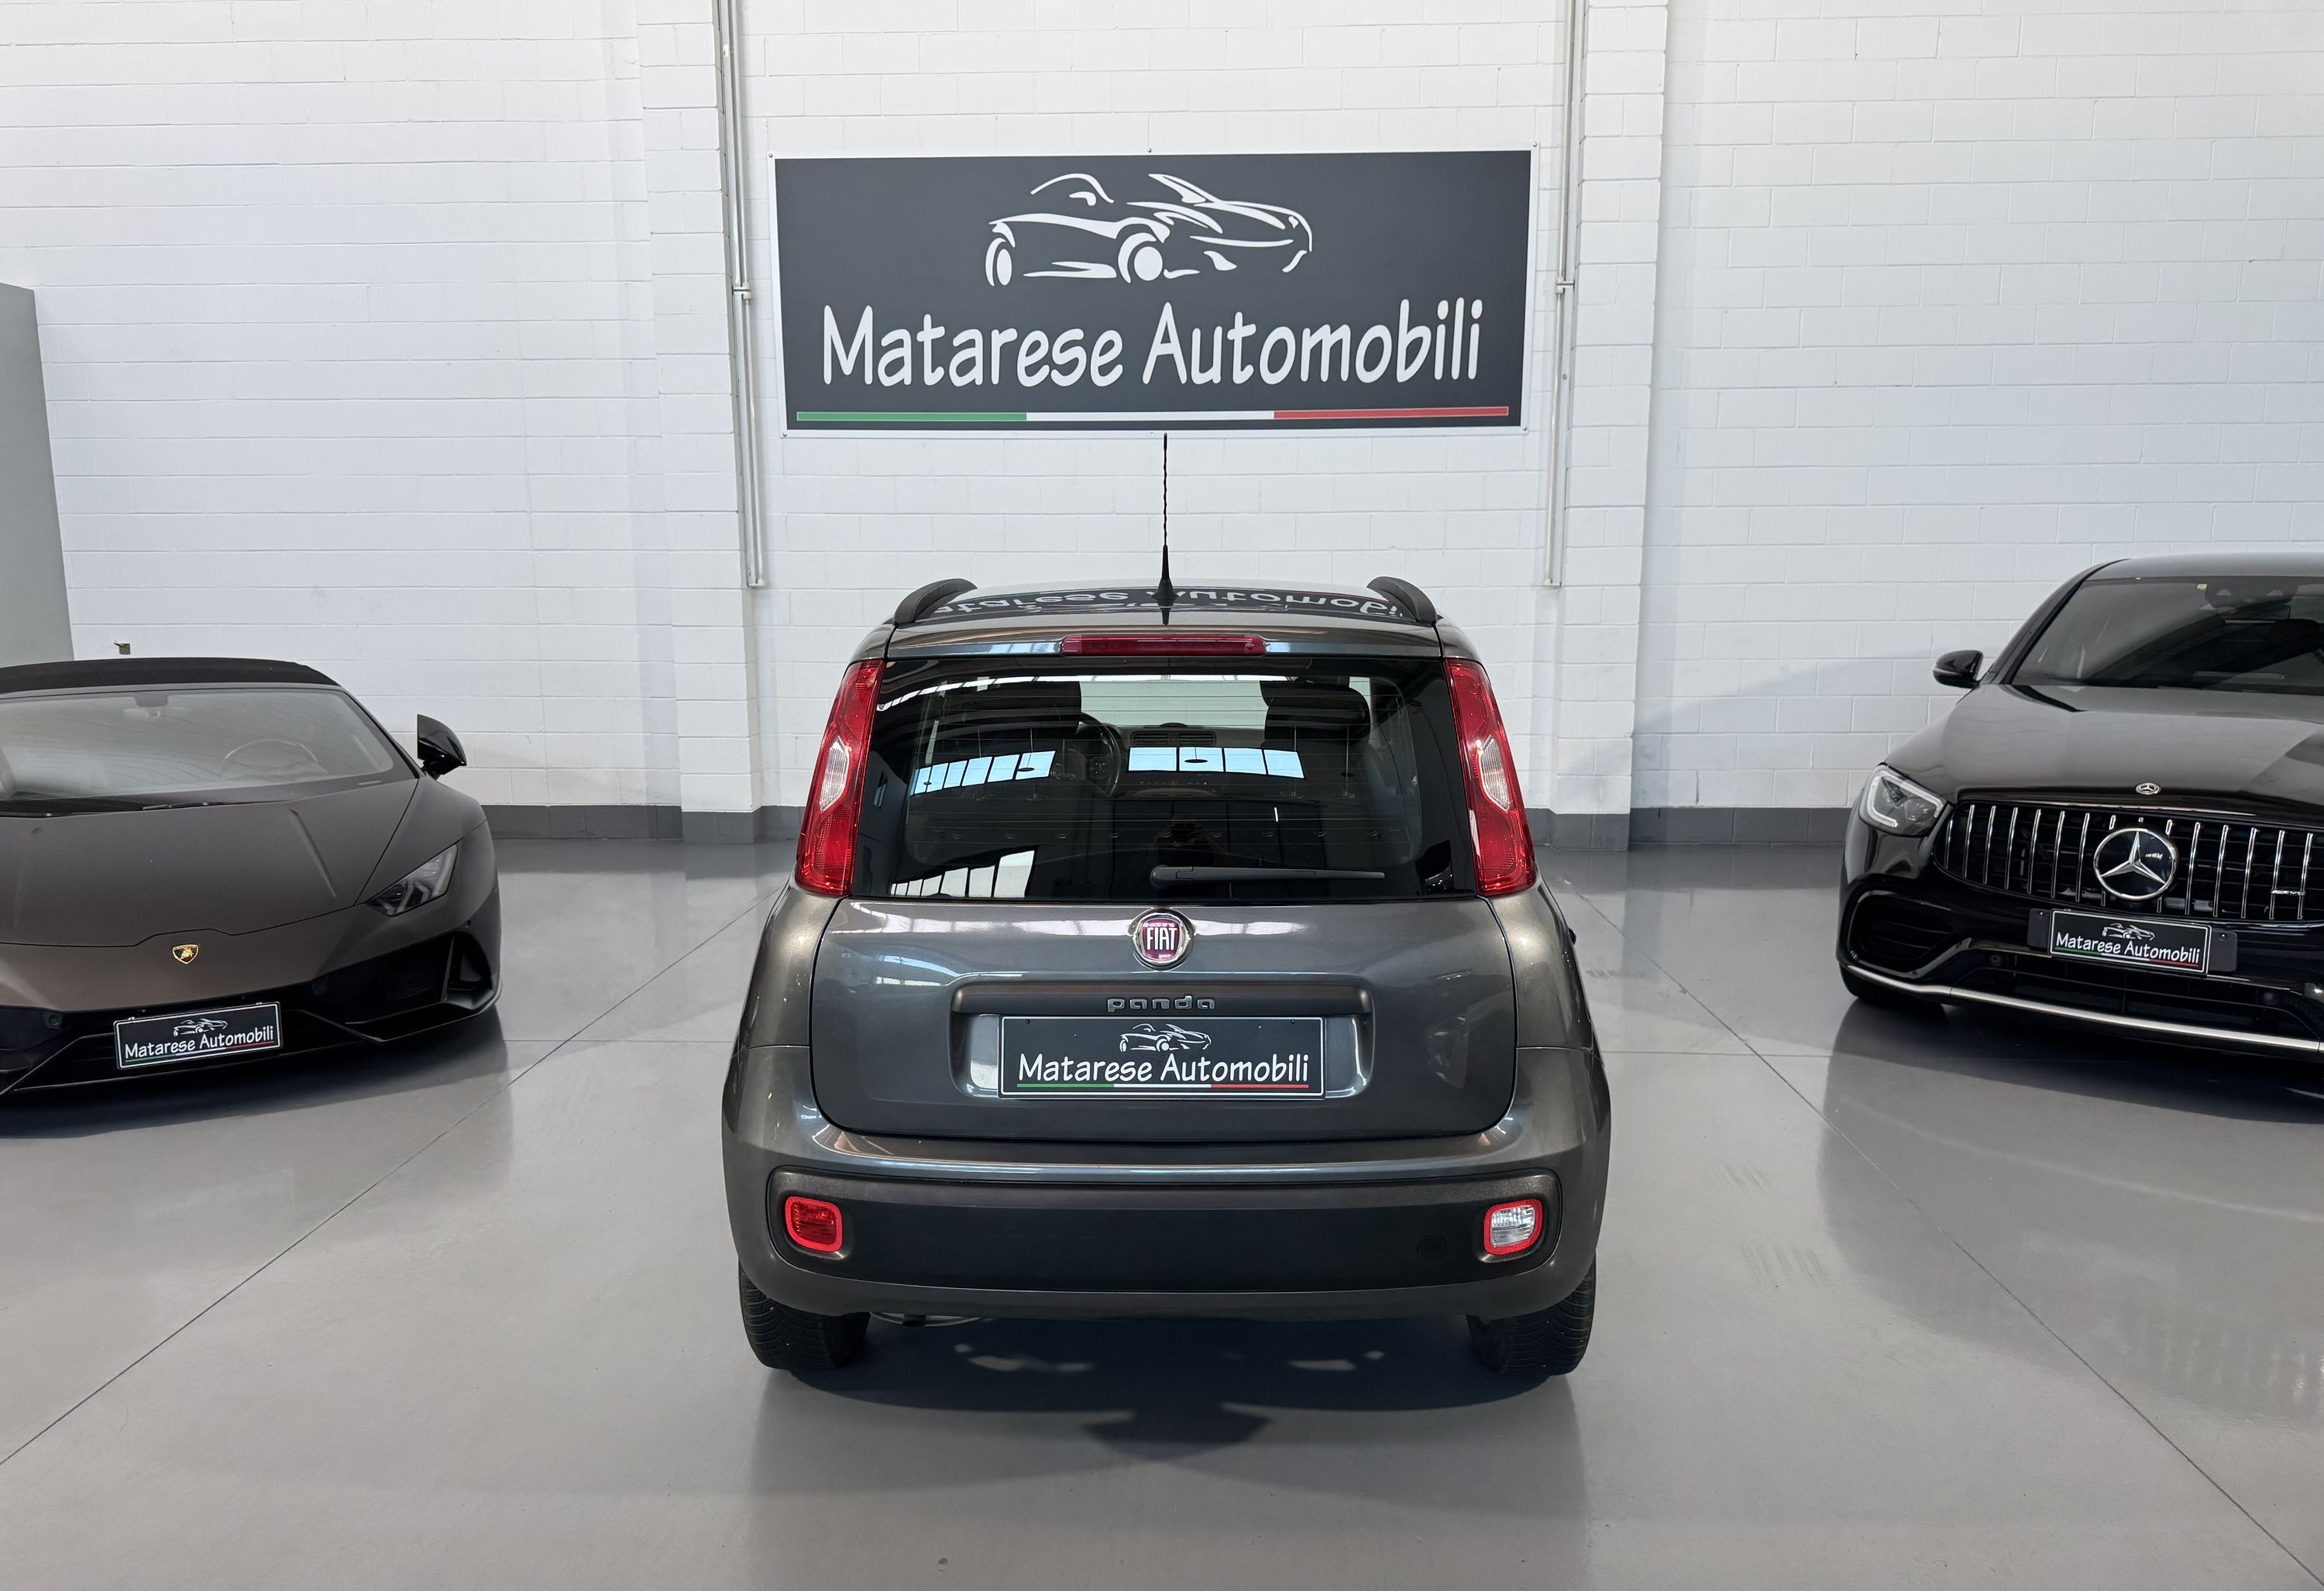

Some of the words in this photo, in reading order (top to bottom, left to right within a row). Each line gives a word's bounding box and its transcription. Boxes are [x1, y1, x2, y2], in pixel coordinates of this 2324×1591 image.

[823, 304, 1123, 387] Matarese
[1142, 297, 1483, 385] Automobili
[1147, 927, 1177, 950] FIAT
[2056, 932, 2121, 954] Matarese
[2124, 940, 2200, 964] Automobili
[1107, 995, 1215, 1012] panda
[125, 1039, 196, 1060] Matarese
[199, 1026, 273, 1050] Automobili
[1019, 1053, 1152, 1082] Matarese
[1160, 1053, 1309, 1082] Automobili
